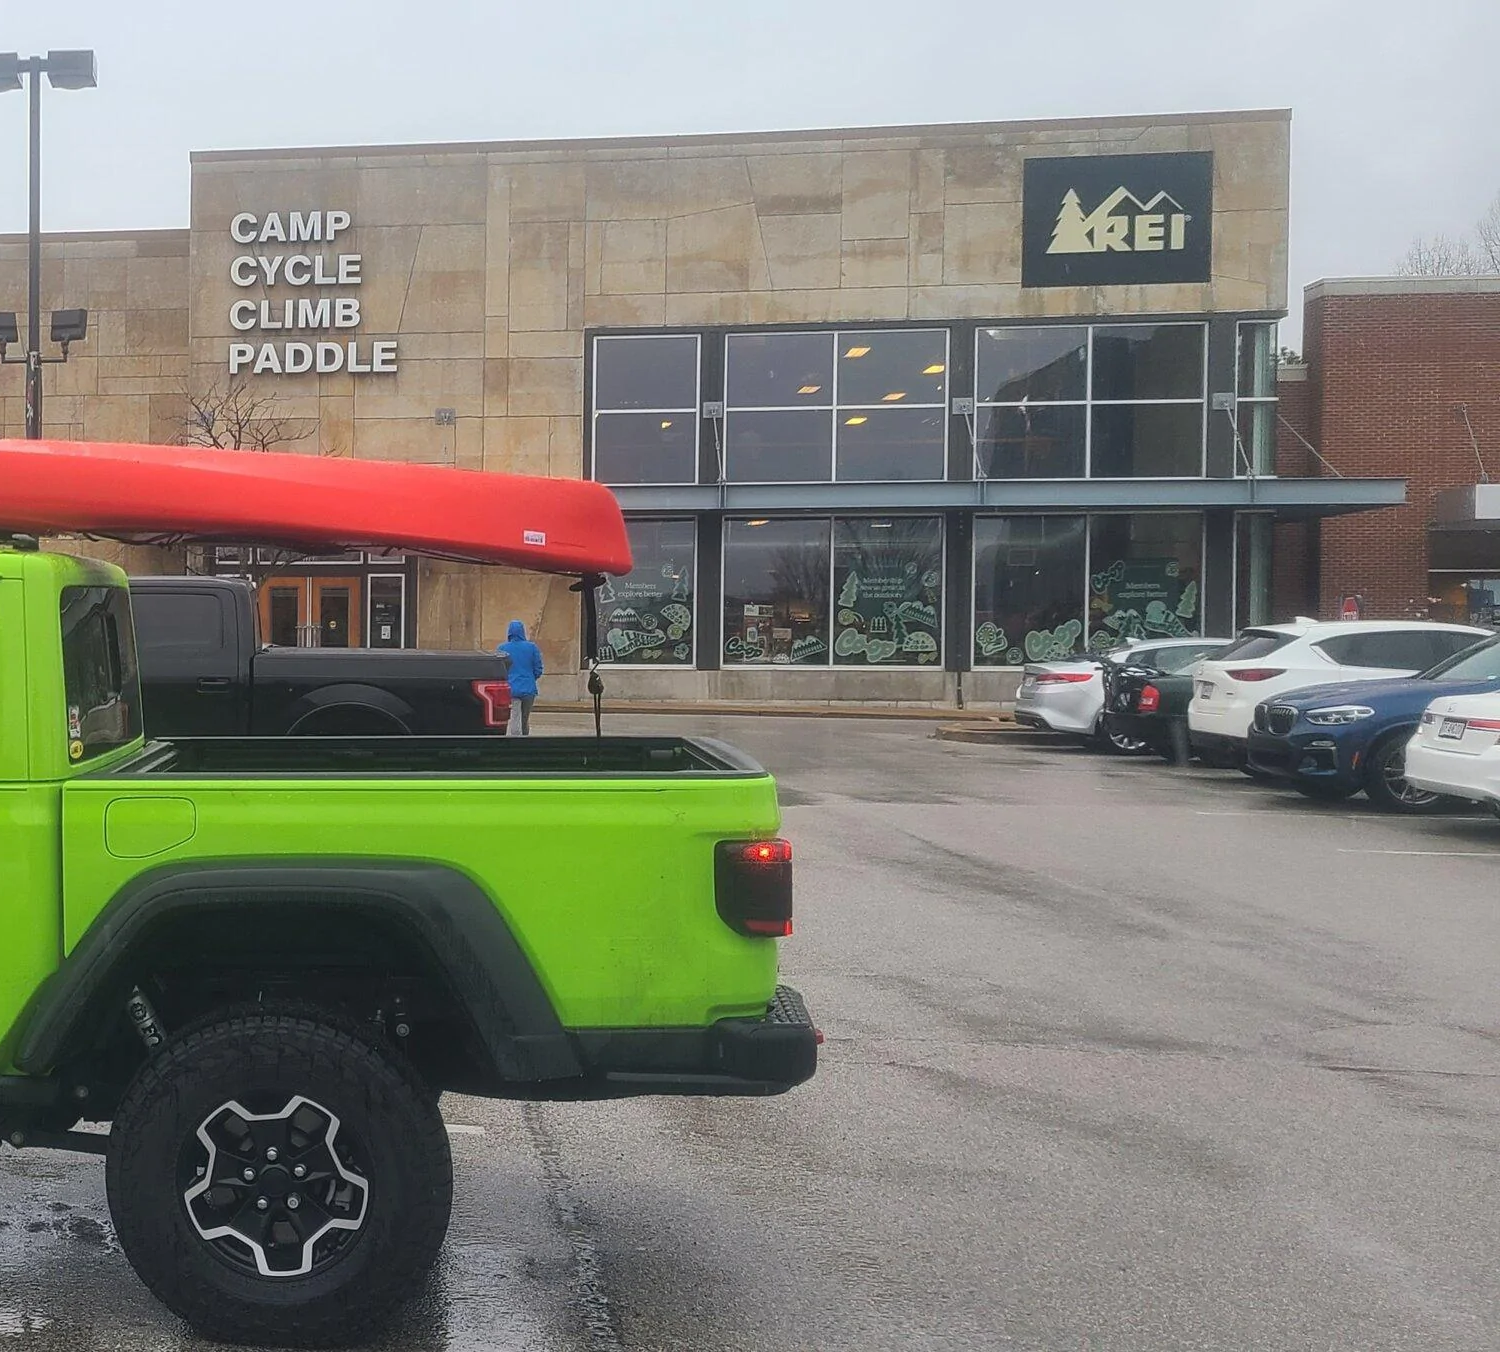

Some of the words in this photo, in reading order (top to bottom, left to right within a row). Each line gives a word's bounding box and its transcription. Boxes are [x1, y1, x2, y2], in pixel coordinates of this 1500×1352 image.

[230, 210, 351, 244] CAMP
[230, 254, 363, 287] CYCLE
[229, 298, 361, 331] CLIMB
[228, 341, 398, 375] PADDLE
[624, 582, 657, 590] Members
